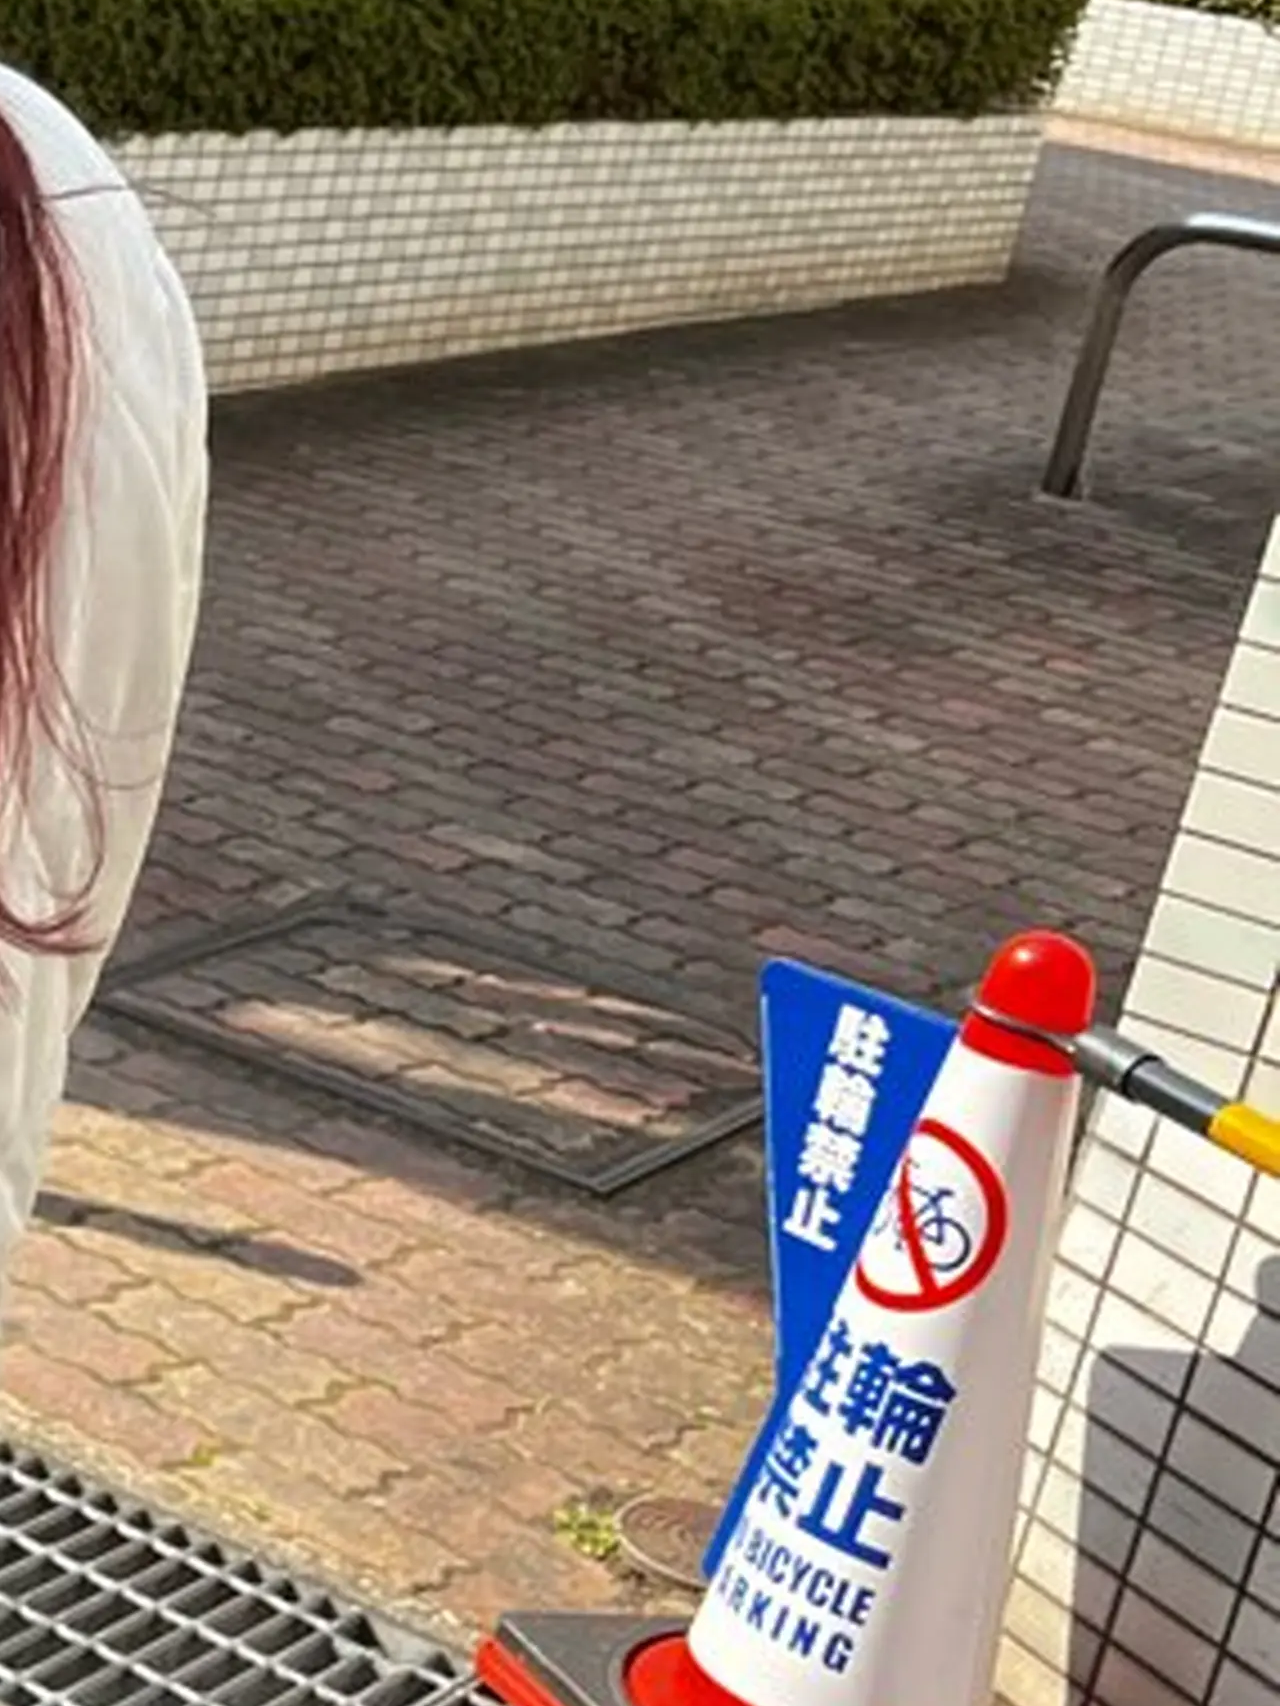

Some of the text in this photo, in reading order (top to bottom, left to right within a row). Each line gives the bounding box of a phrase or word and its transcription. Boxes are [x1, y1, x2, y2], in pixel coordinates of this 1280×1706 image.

[782, 1004, 890, 1251] 駐輪禁止
[743, 1527, 877, 1627] BICYCLE
